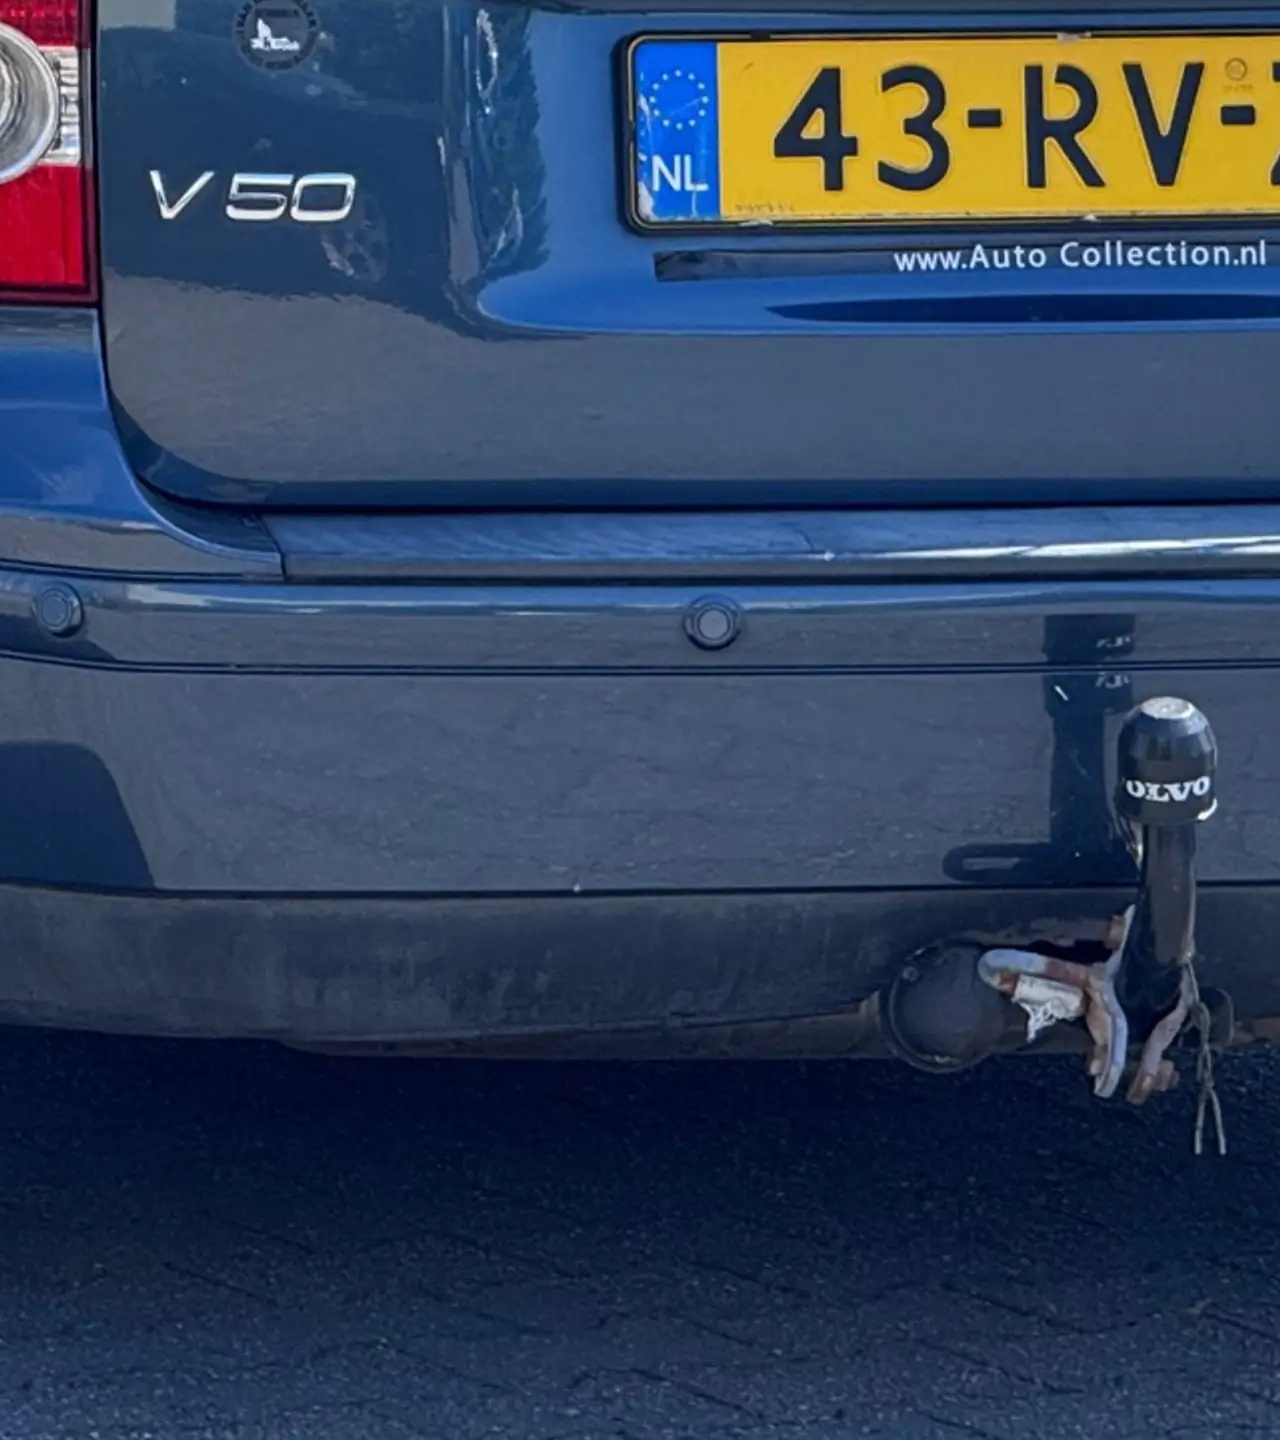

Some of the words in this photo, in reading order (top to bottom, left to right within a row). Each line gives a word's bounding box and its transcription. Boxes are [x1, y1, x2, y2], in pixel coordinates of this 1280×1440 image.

[651, 154, 709, 192] NL
[894, 244, 1047, 272] www.Auto
[1059, 240, 1267, 268] Collection.nl
[1125, 775, 1211, 802] OLVO
